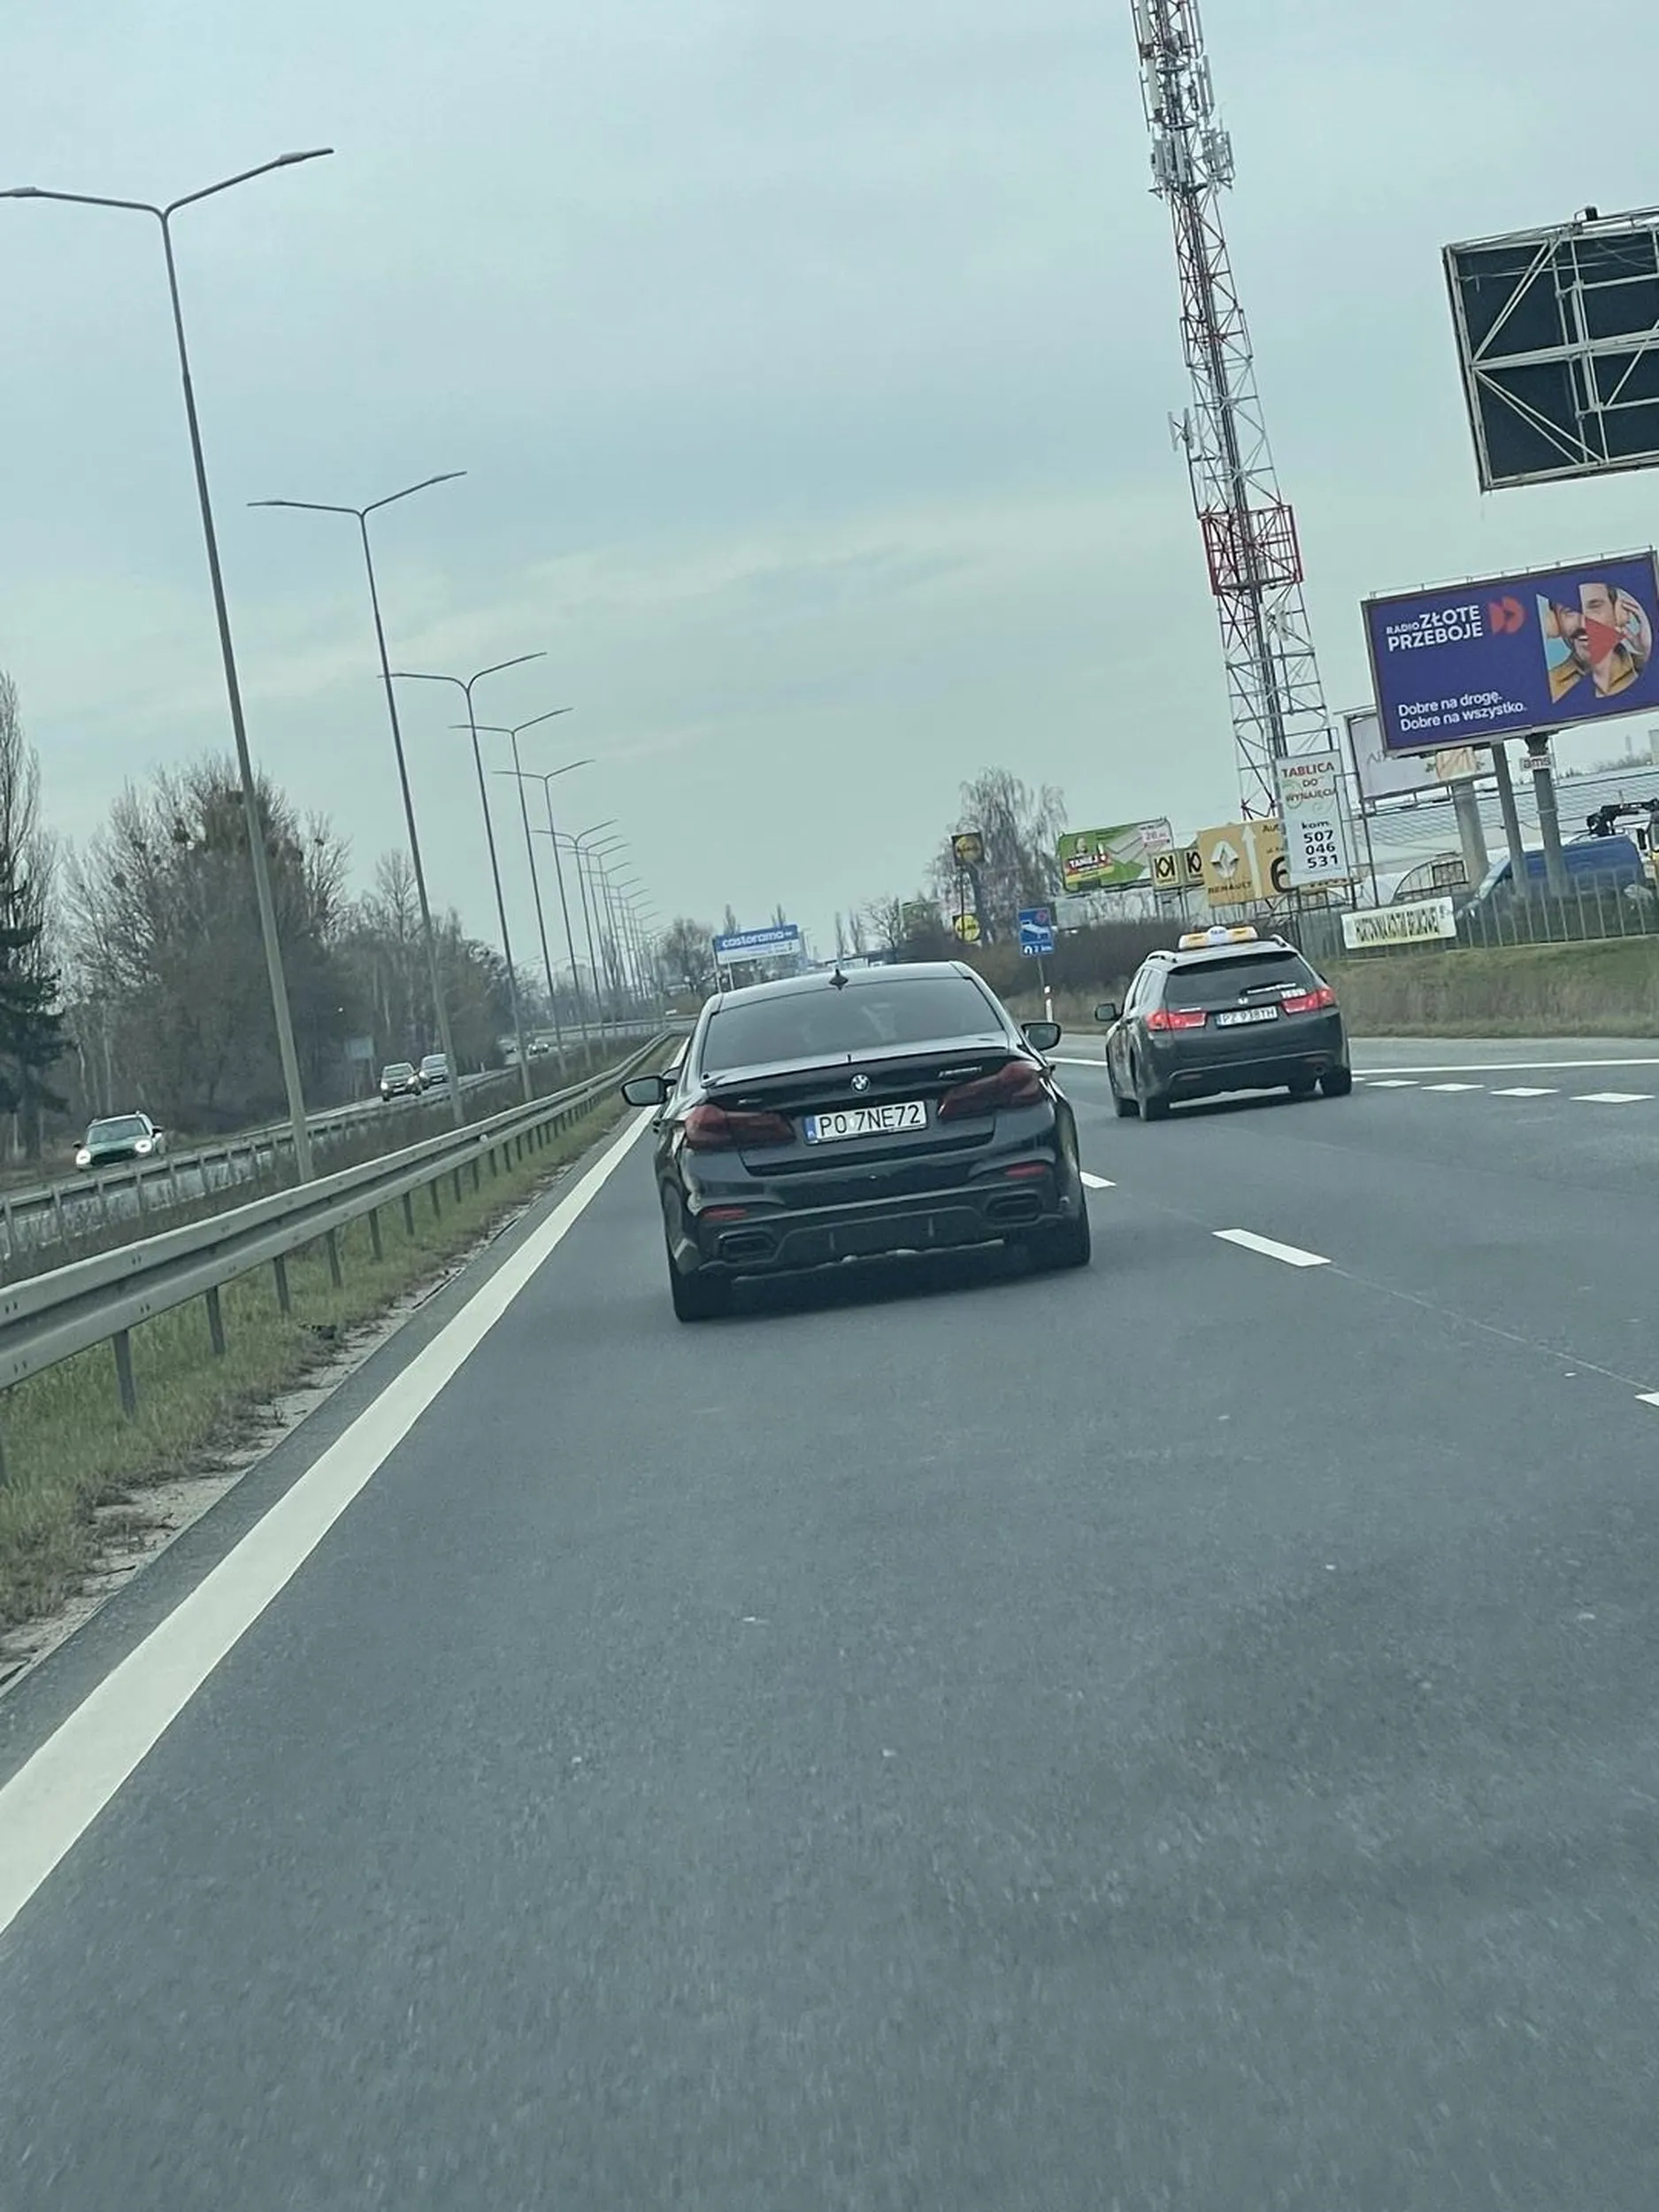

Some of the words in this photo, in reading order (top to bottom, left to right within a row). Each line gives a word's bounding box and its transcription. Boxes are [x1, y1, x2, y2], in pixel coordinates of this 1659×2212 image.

[1386, 622, 1420, 634] RADIO
[1419, 605, 1480, 628] ZŁOTE
[1387, 621, 1483, 652] PRZEBOJE
[1398, 699, 1439, 717] Dobre
[1440, 697, 1458, 710] na
[1460, 690, 1503, 707] drogę.
[1401, 715, 1440, 732] Dobre
[1442, 713, 1461, 725] na
[1462, 701, 1527, 722] wszystko.
[1281, 762, 1335, 778] TABLICA
[1302, 778, 1318, 787] DO
[1303, 830, 1333, 843] 507
[1305, 841, 1336, 856] 046
[1308, 855, 1339, 869] 531
[1208, 880, 1252, 895] RENAULT
[721, 931, 784, 948] castorama
[819, 1114, 847, 1137] PO
[855, 1103, 921, 1132] 7NE72
